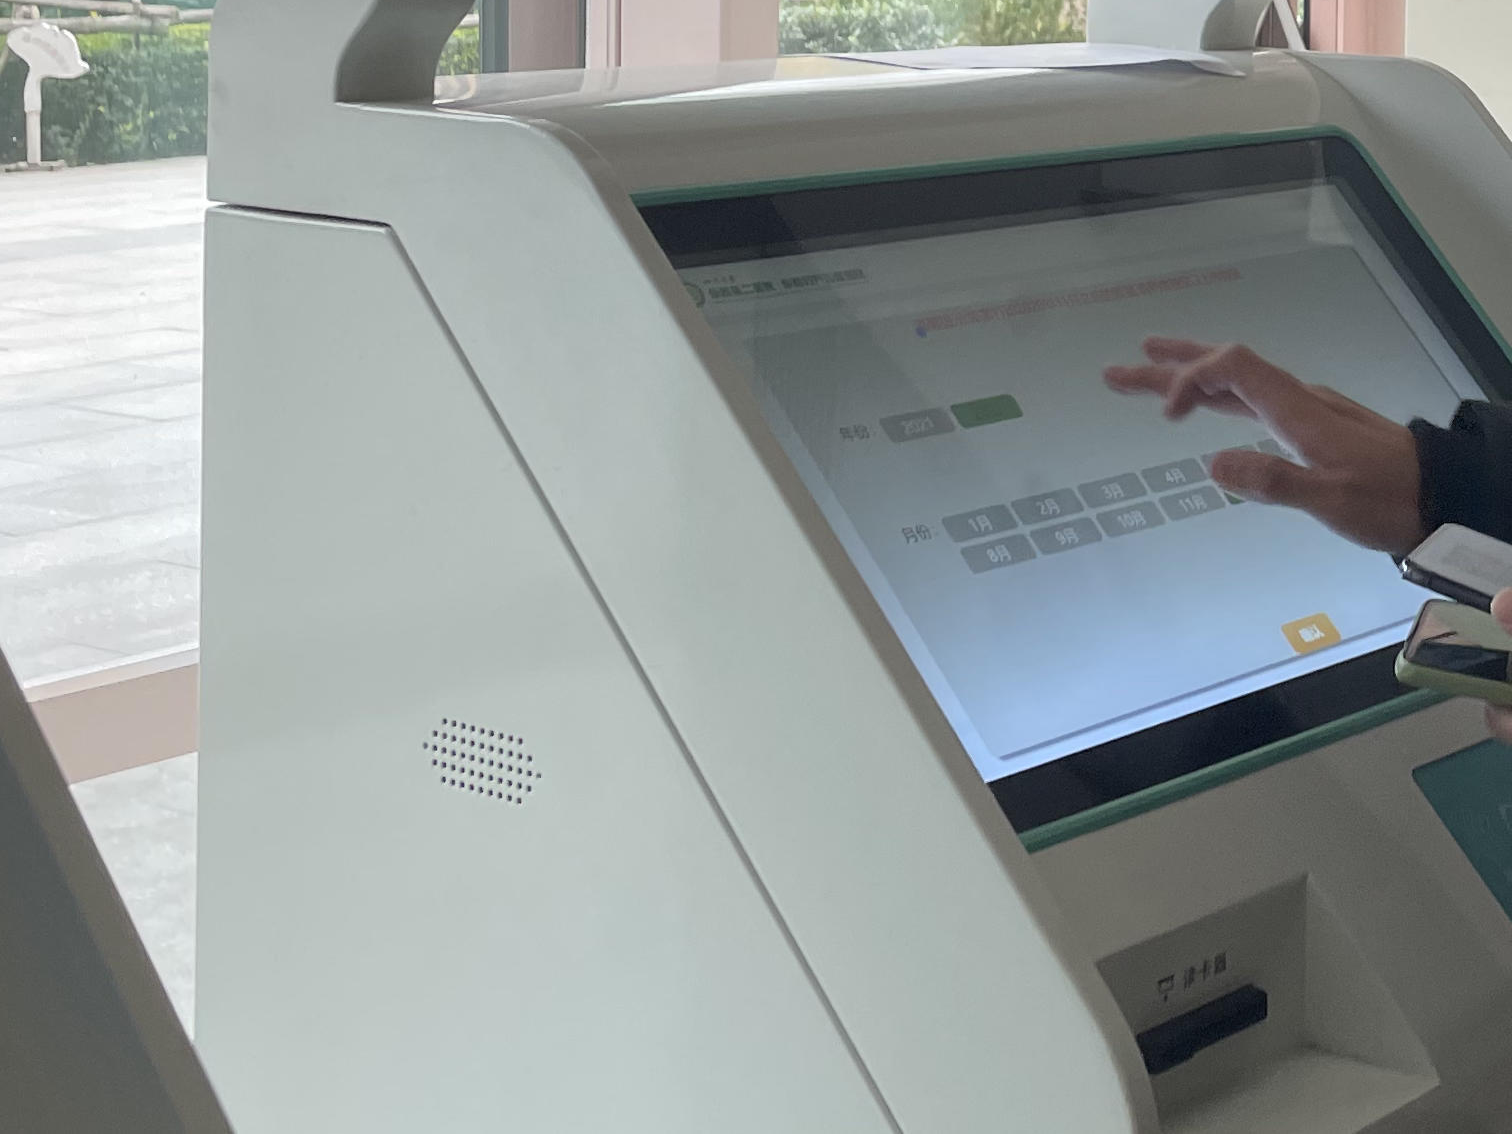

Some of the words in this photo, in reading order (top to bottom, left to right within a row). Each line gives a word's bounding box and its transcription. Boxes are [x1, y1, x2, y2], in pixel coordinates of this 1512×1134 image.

[967, 514, 994, 534] 1月
[1038, 497, 1062, 516] 2月
[1103, 482, 1125, 501] 3月
[1164, 467, 1187, 485] 4月
[986, 544, 1013, 564] 8月
[1054, 526, 1081, 546] 9月
[1116, 509, 1147, 529] 10月
[1178, 495, 1208, 514] 11月
